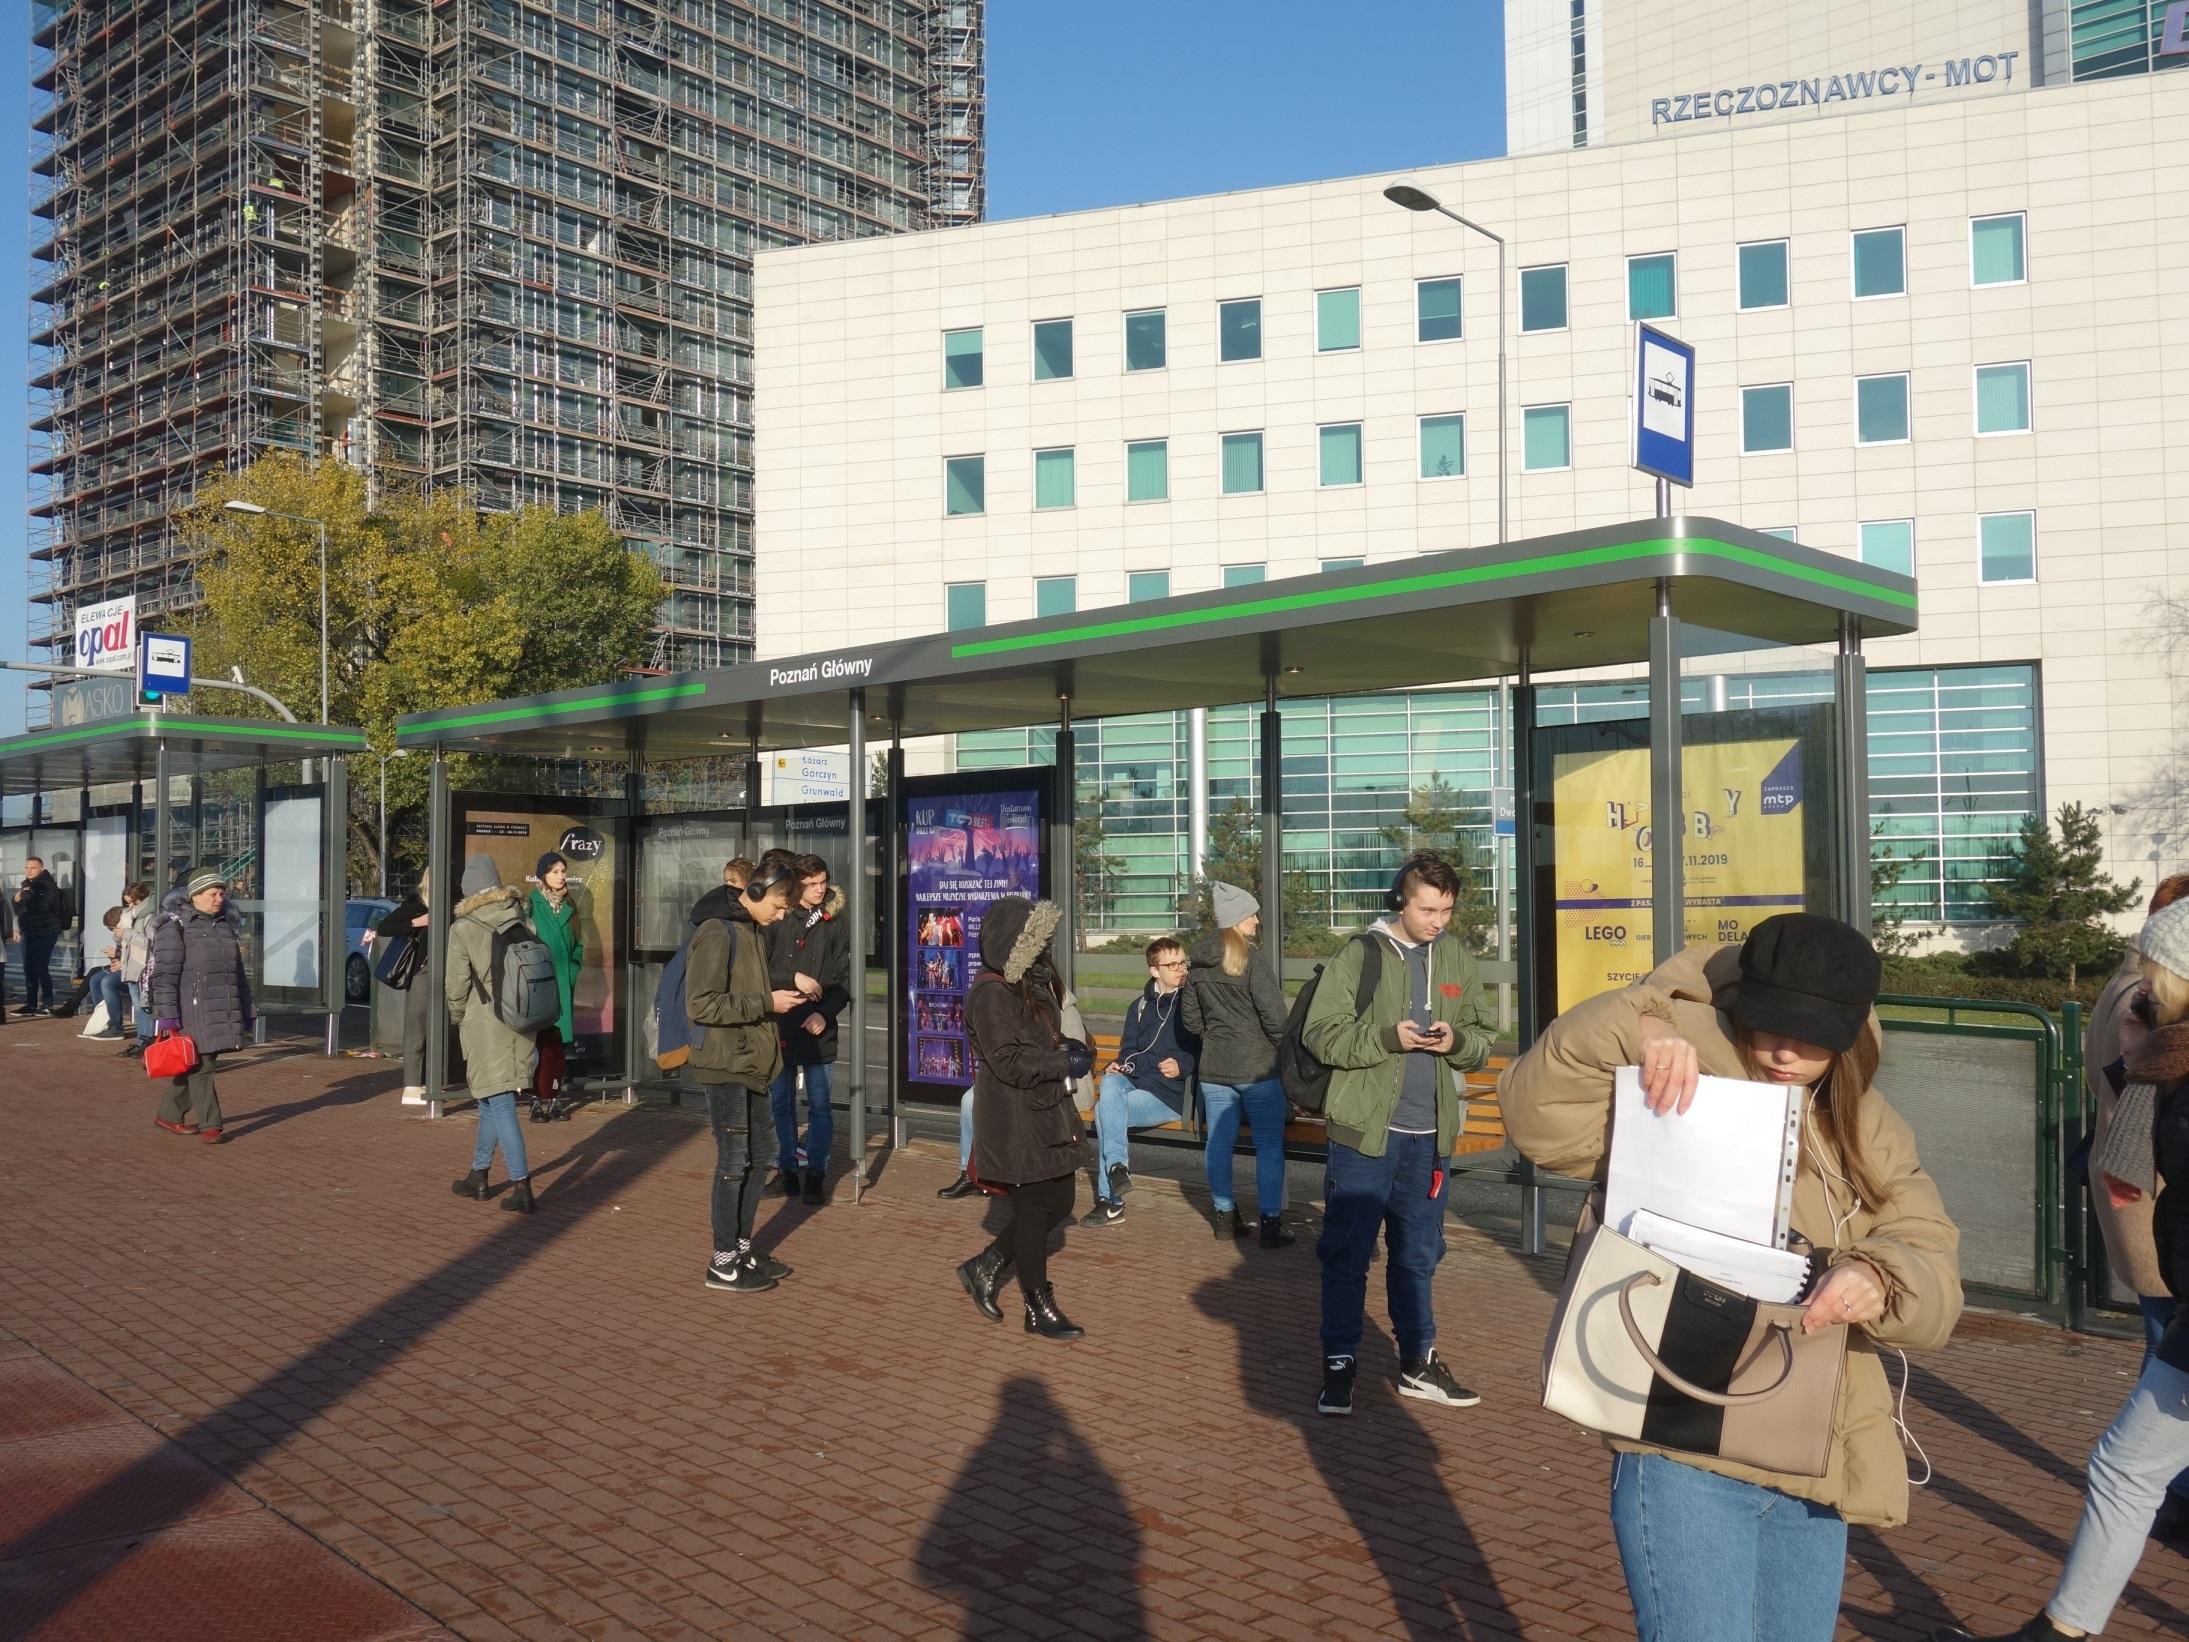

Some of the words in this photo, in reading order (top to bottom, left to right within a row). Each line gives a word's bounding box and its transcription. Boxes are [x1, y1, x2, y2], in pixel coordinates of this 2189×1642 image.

[81, 605, 122, 624] ELEWACJE
[80, 611, 129, 667] opal
[770, 662, 818, 687] Poznań
[821, 659, 873, 678] Główny
[801, 785, 844, 798] Grunwald
[1763, 793, 1794, 806] mtp
[786, 817, 814, 830] Poznań
[815, 816, 846, 830] Główny
[915, 809, 935, 826] KUP
[1718, 919, 1738, 930] MO
[1585, 926, 1627, 941] LEGO
